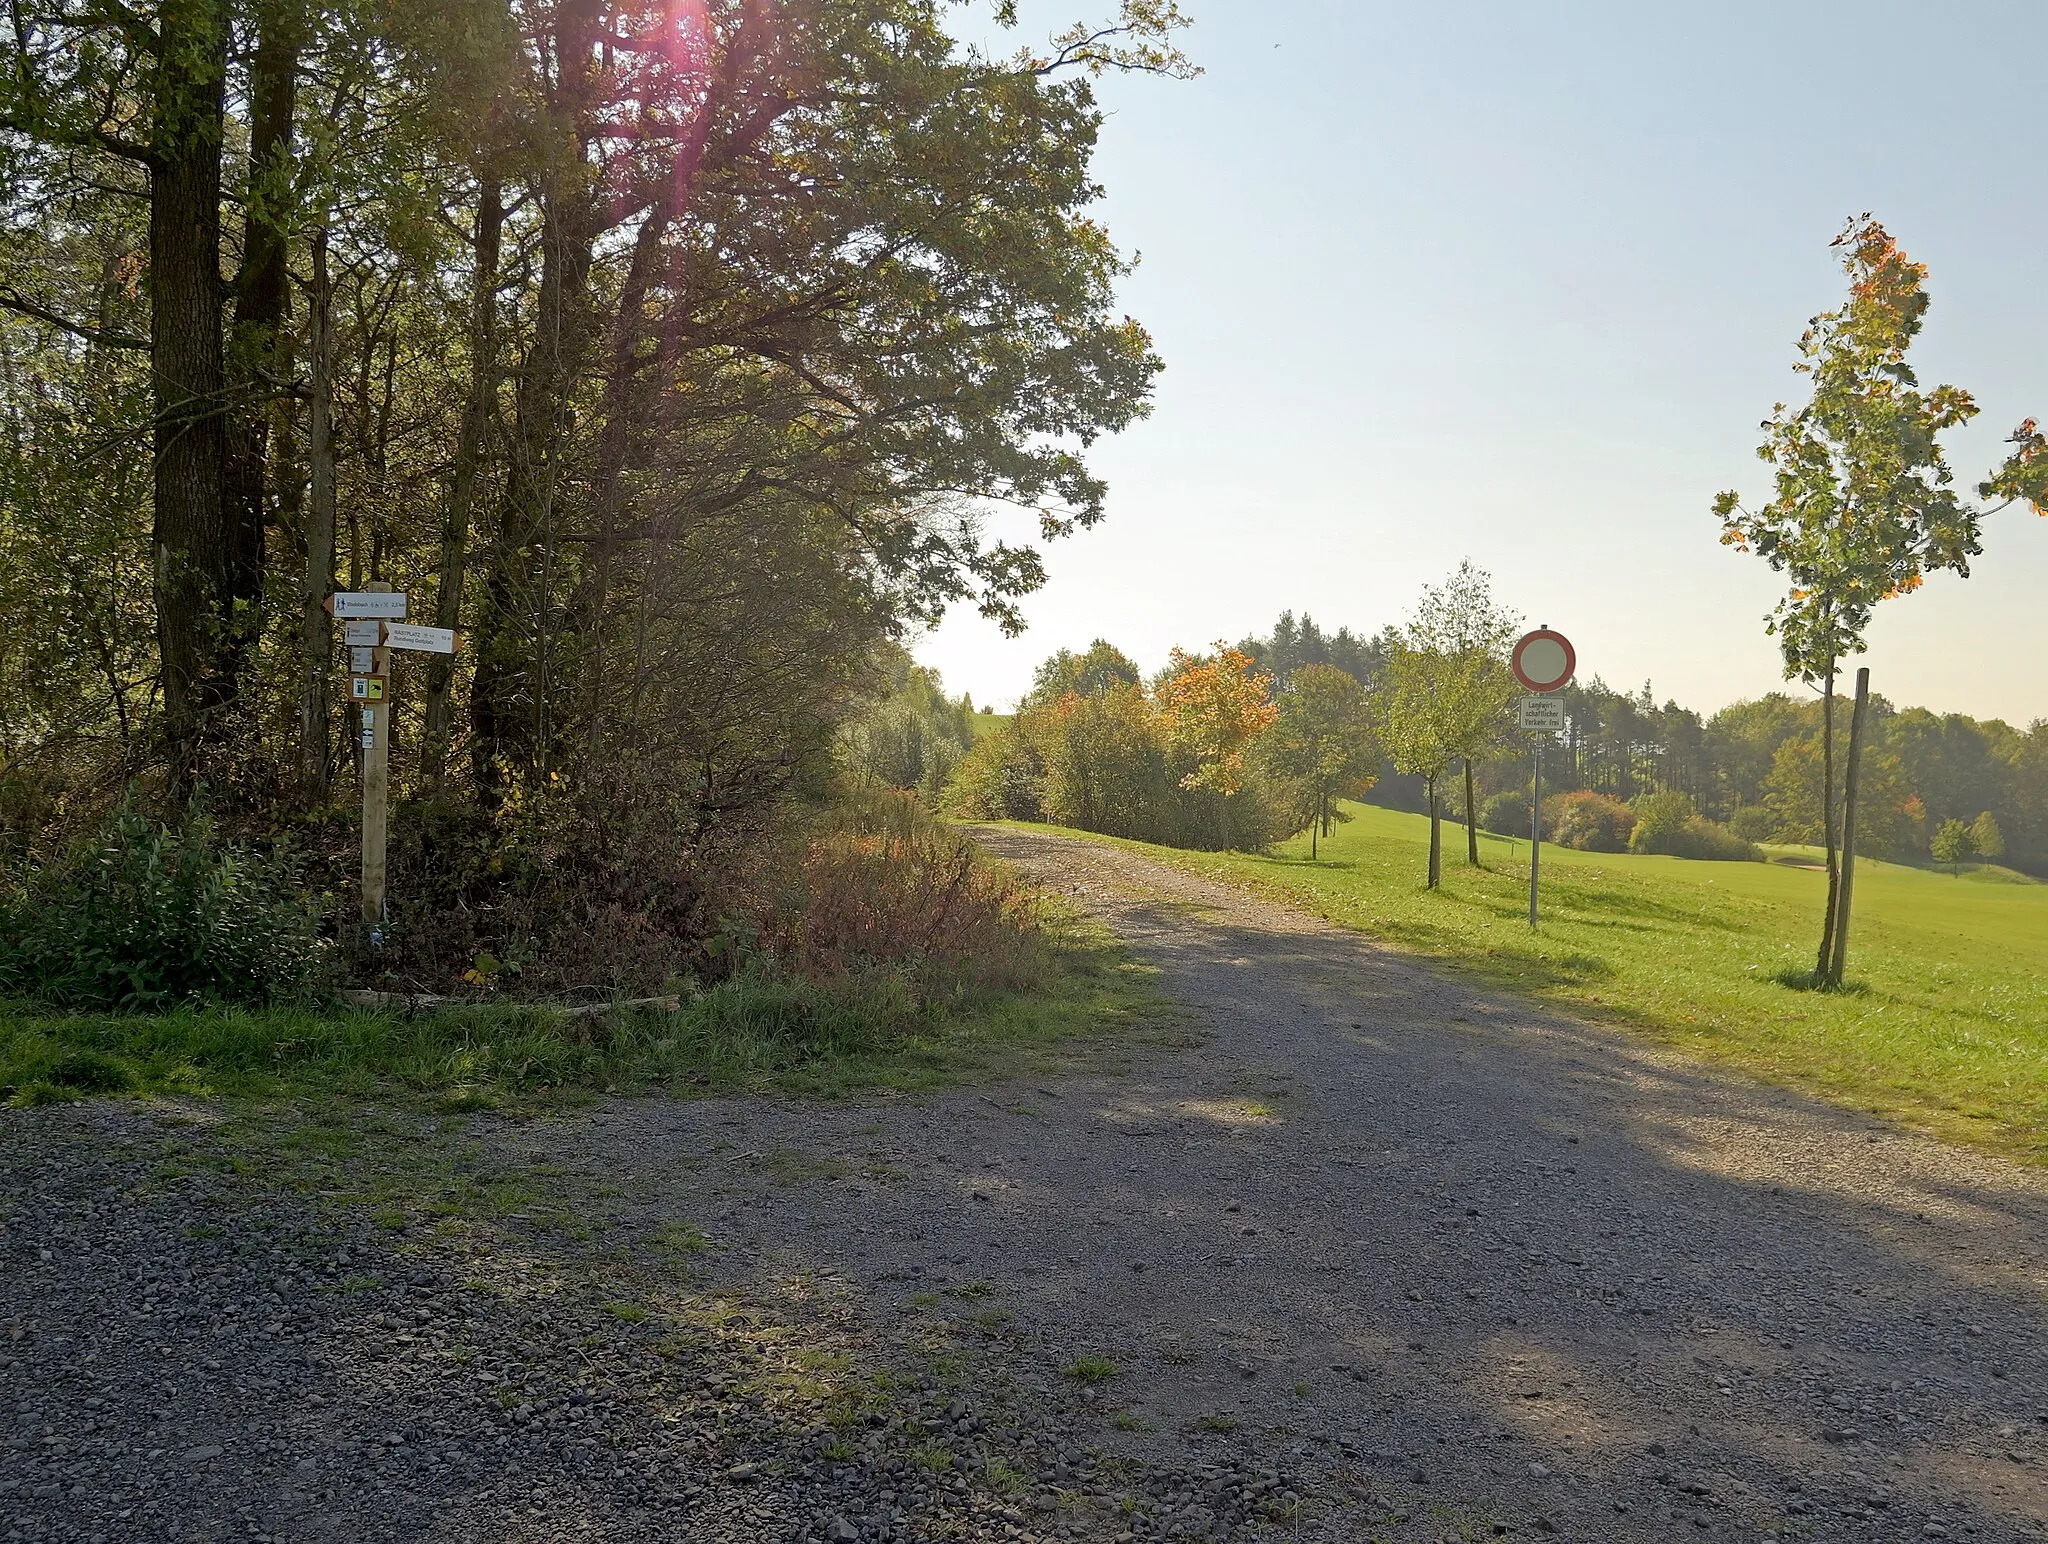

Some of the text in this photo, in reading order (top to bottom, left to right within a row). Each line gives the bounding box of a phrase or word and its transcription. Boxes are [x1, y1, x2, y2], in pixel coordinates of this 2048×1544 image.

[394, 630, 421, 638] RASTPLATZ
[393, 635, 415, 644] Rundweg
[1528, 701, 1556, 709] Landwirt-
[1524, 718, 1560, 726] Verkehr frei
